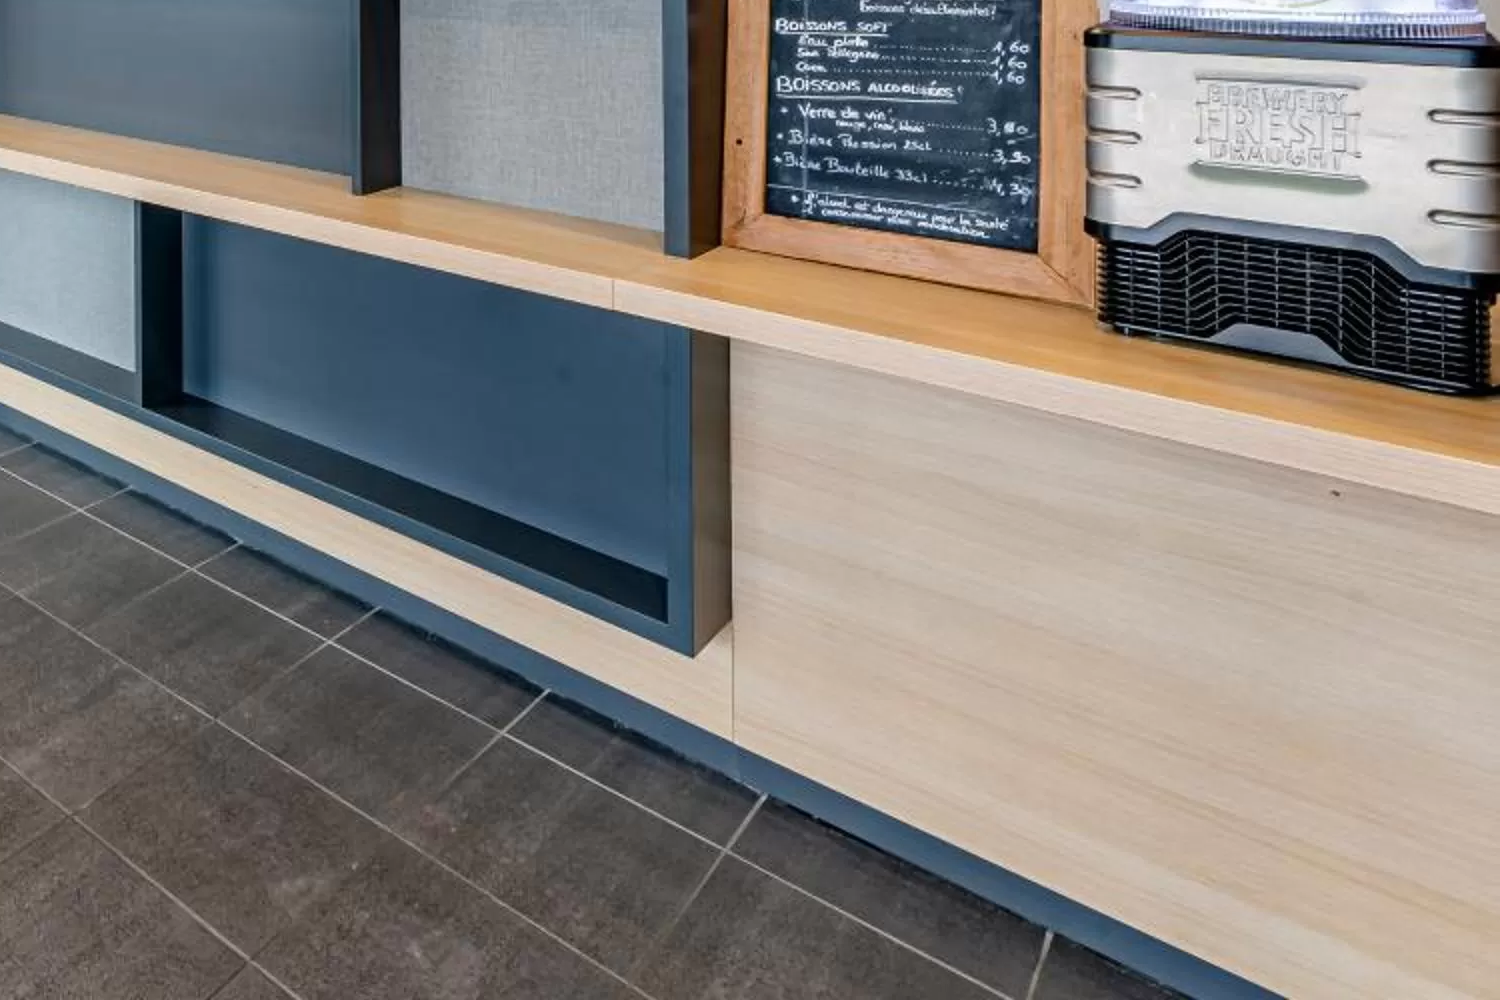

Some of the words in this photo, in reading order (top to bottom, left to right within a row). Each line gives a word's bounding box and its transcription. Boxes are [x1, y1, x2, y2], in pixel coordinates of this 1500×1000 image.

[776, 75, 861, 93] BOISSONS
[1207, 83, 1349, 115] BREWERY
[1200, 108, 1359, 153] FRESH
